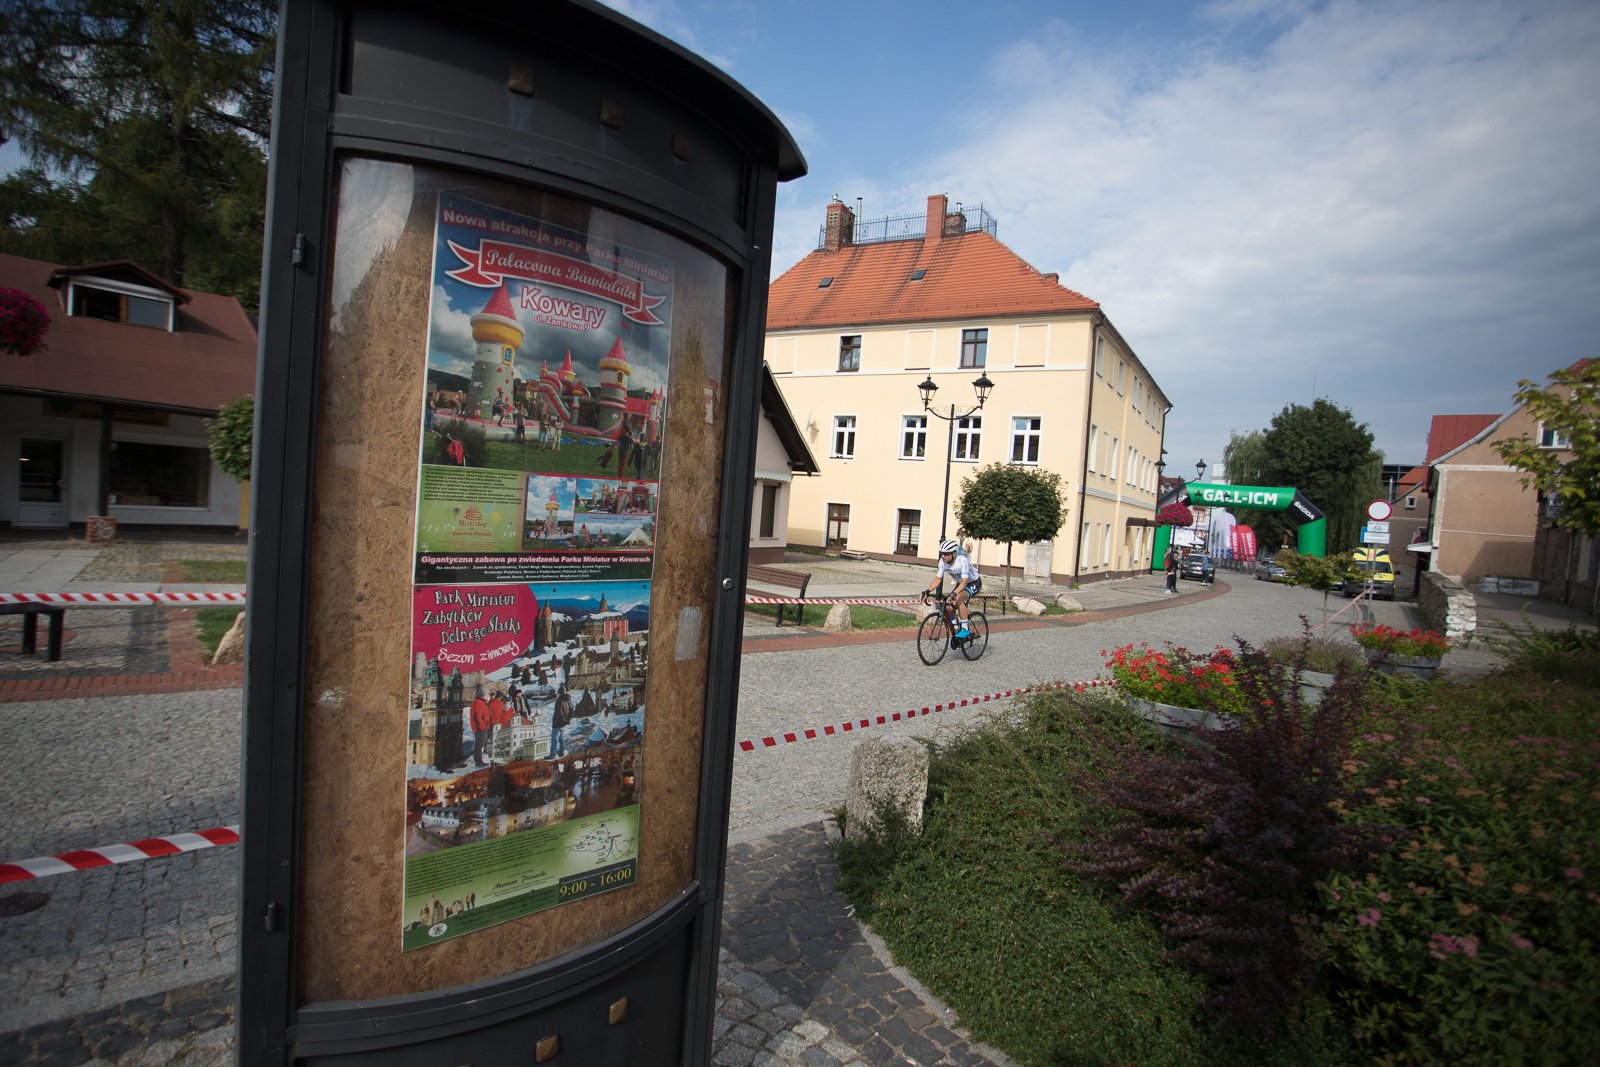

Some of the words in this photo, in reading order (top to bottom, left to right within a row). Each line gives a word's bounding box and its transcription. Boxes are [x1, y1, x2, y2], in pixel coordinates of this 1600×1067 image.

[443, 209, 487, 228] Nowa
[491, 220, 550, 242] atrakcja
[553, 235, 582, 252] przy
[624, 257, 670, 282] Miniatur
[485, 249, 561, 277] Pałacowa
[566, 266, 637, 300] Bawialnia
[520, 285, 606, 329] Kowary
[534, 315, 545, 325] ul.
[546, 316, 583, 331] Zamkowa
[584, 322, 590, 332] 9
[421, 556, 473, 564] Gigantyczna
[434, 589, 464, 607] Park
[466, 592, 516, 607] Miniatur
[422, 608, 483, 628] Zabytków
[441, 627, 487, 645] Dolnego
[437, 648, 474, 664] Sezon
[479, 640, 520, 662] zimowy
[559, 880, 588, 897] 9:00
[600, 867, 632, 887] 16:00
